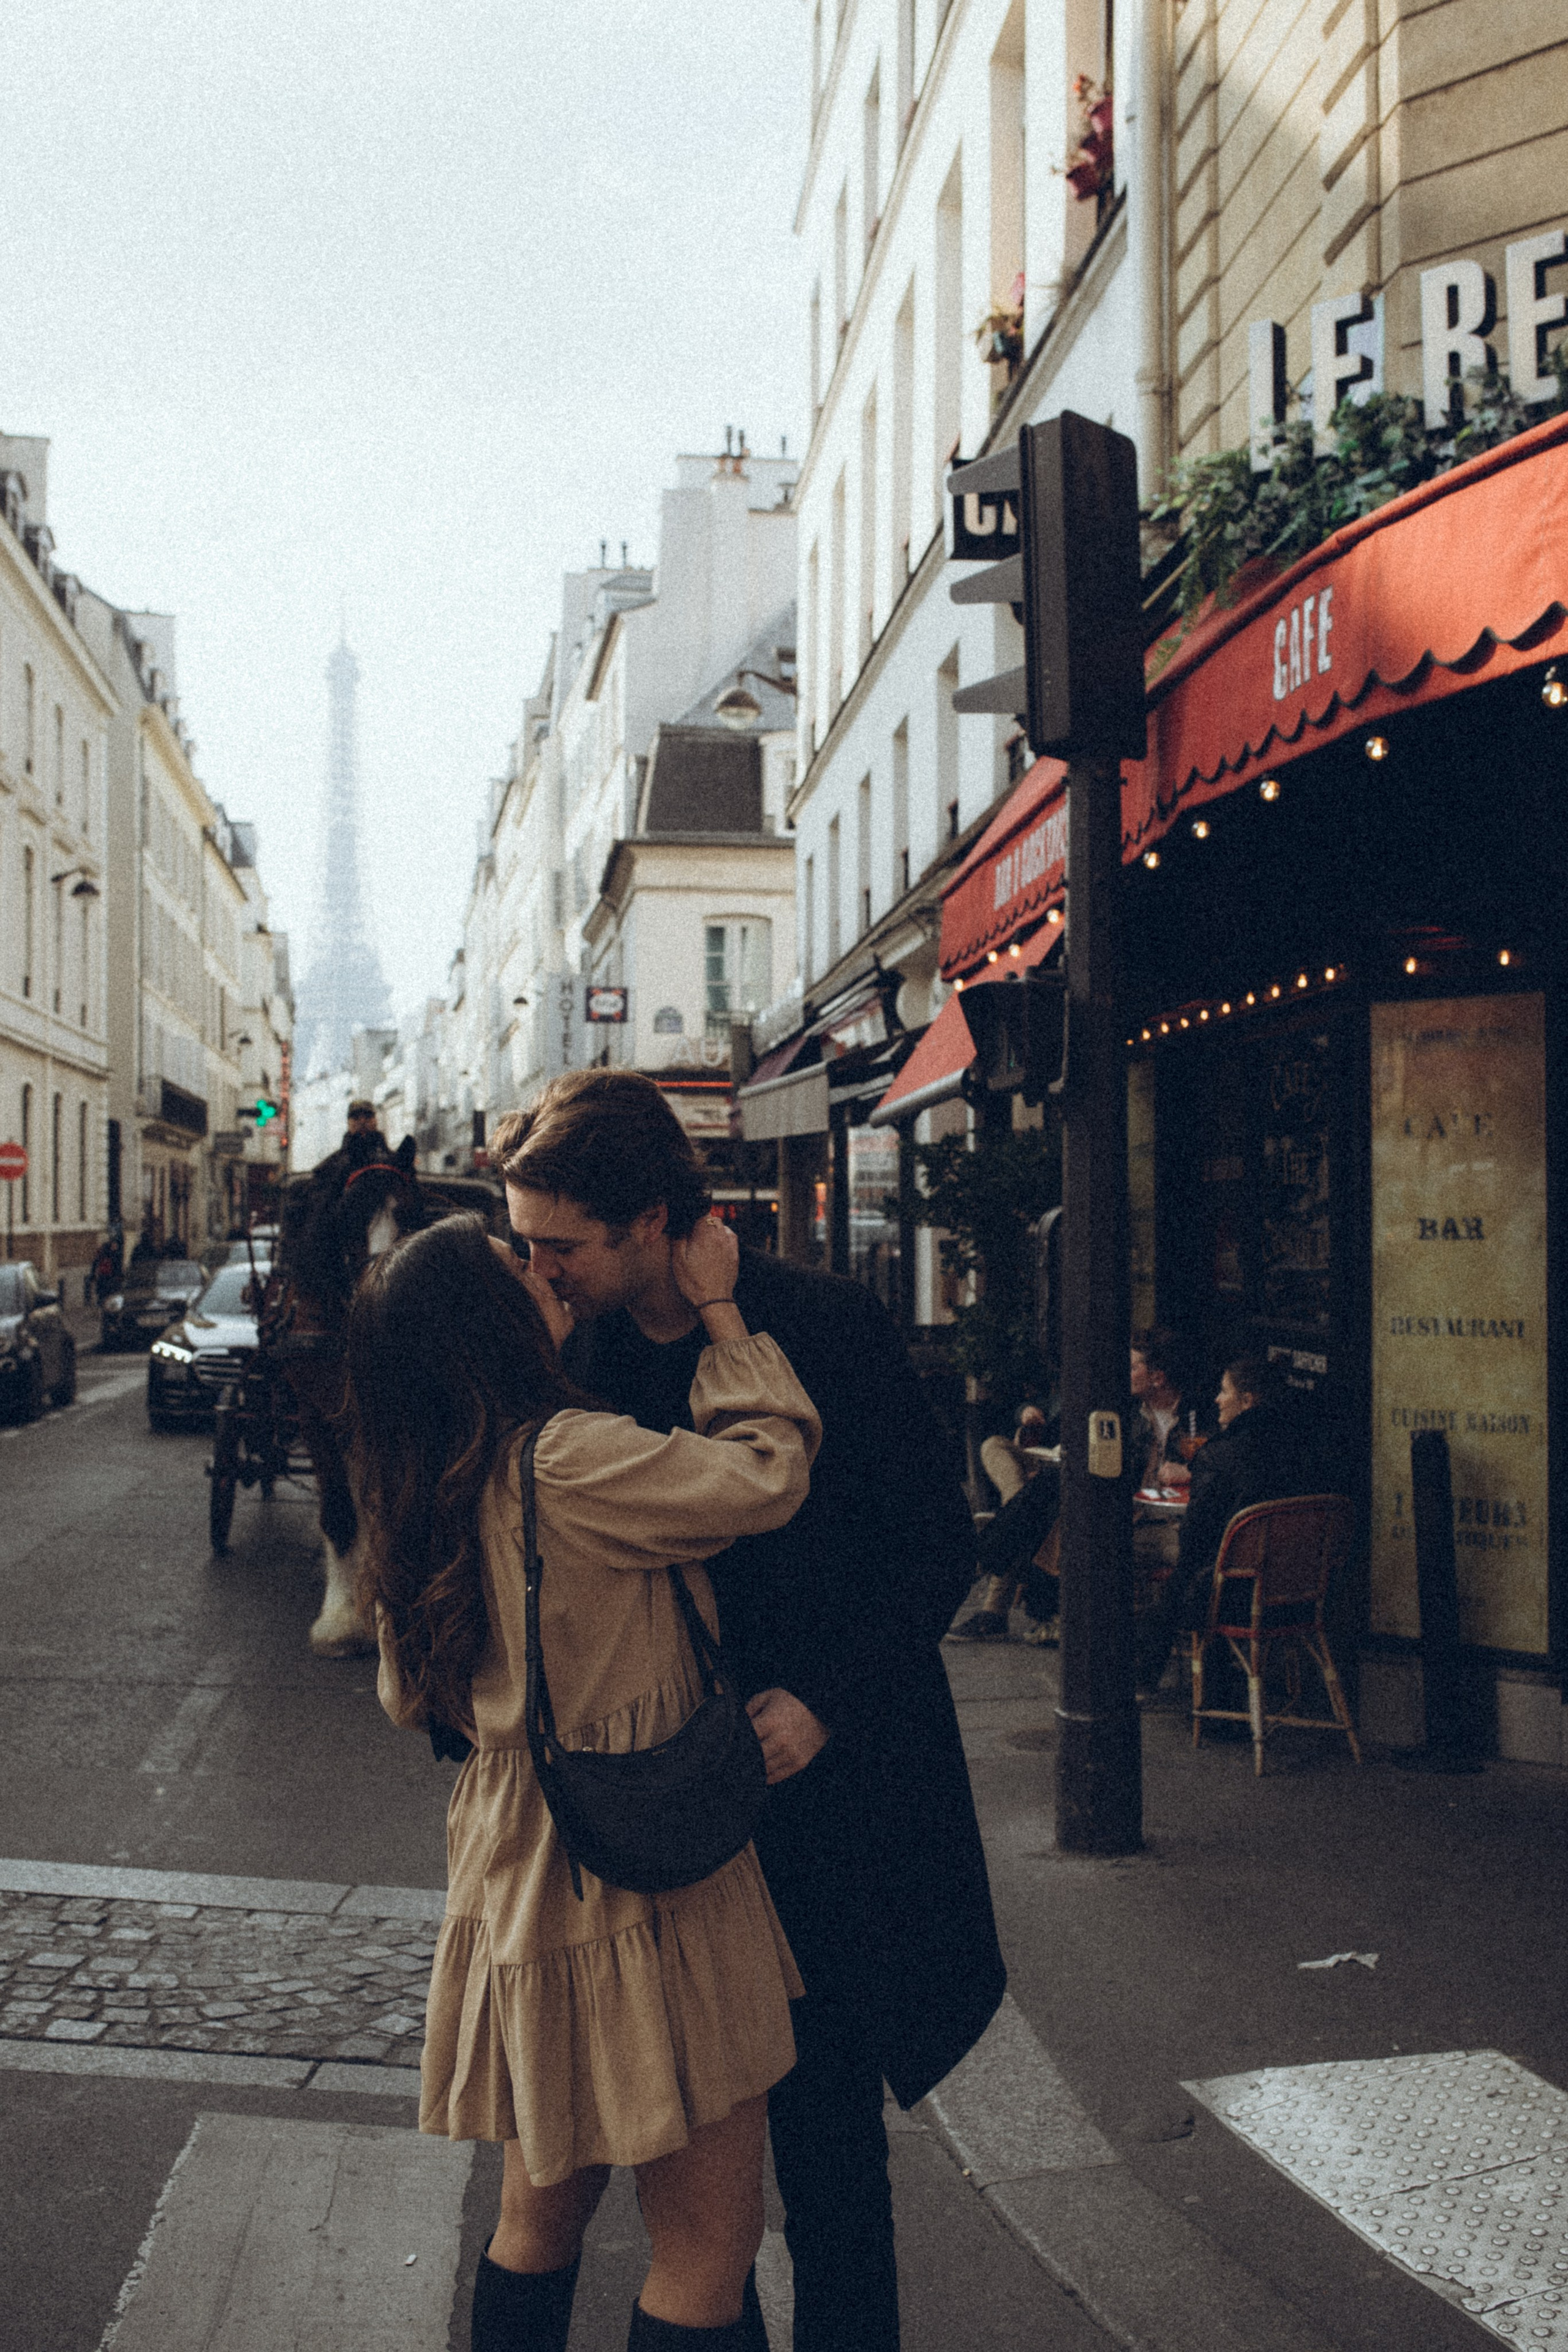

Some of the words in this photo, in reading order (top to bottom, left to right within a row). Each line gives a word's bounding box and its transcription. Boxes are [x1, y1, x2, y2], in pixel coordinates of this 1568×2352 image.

[1273, 584, 1333, 700] CAFE
[559, 981, 574, 1066] HOTEL
[672, 1038, 724, 1068] AU
[1417, 1217, 1485, 1241] BAR
[1390, 1316, 1526, 1339] RESTAURANT
[1391, 1408, 1458, 1431] CUISINE
